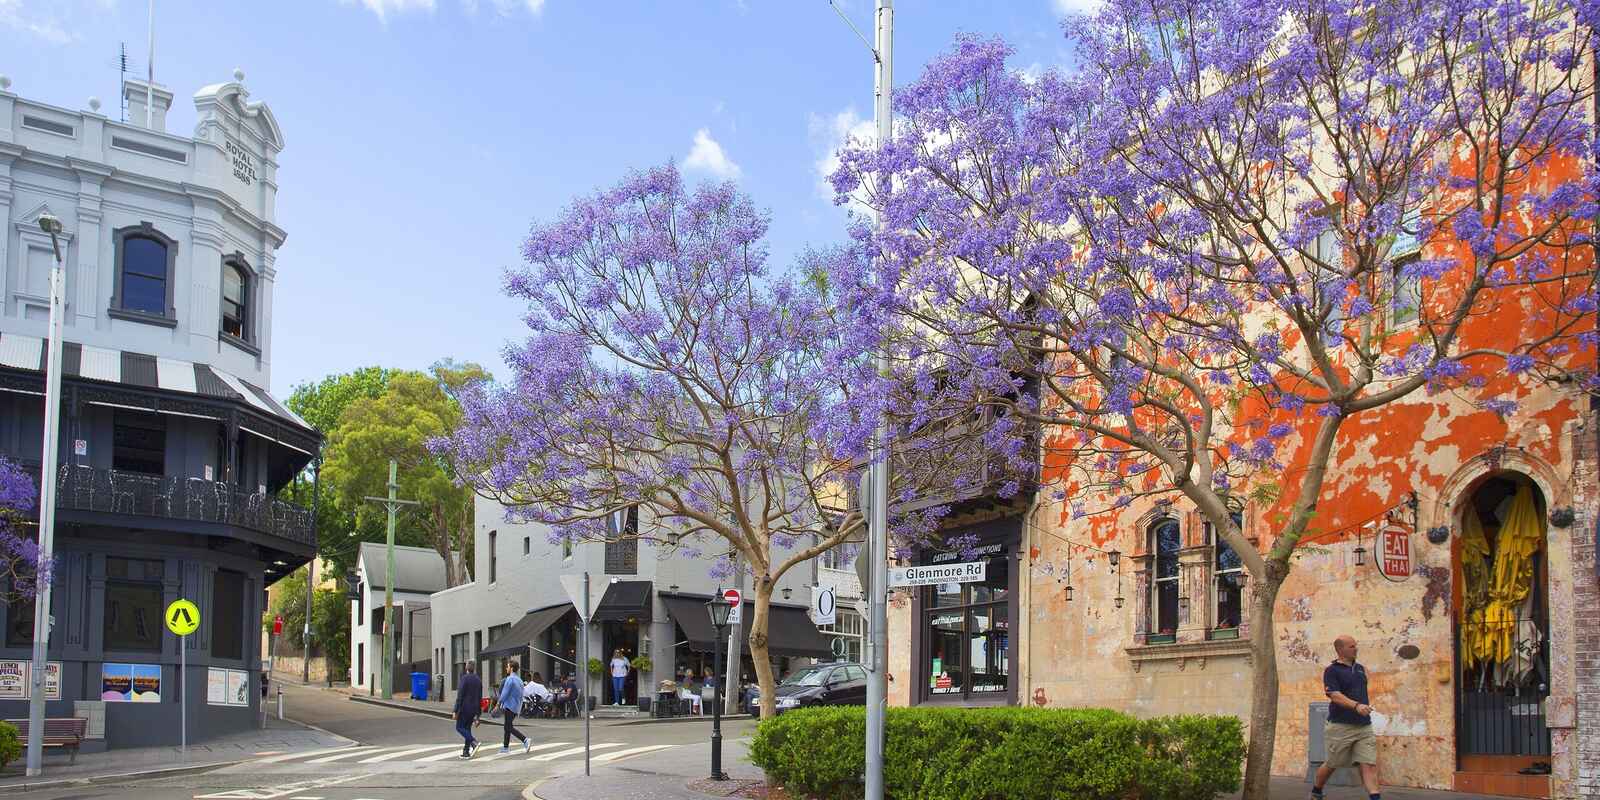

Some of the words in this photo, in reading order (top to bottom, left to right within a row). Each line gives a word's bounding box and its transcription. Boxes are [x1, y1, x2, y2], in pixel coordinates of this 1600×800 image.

[226, 141, 252, 166] ROYAL
[233, 157, 257, 180] HOTEL
[233, 169, 250, 185] 1888
[1384, 534, 1408, 554] EAT
[906, 567, 962, 579] Glenmore
[966, 564, 981, 575] Rd
[1385, 560, 1409, 573] THAI
